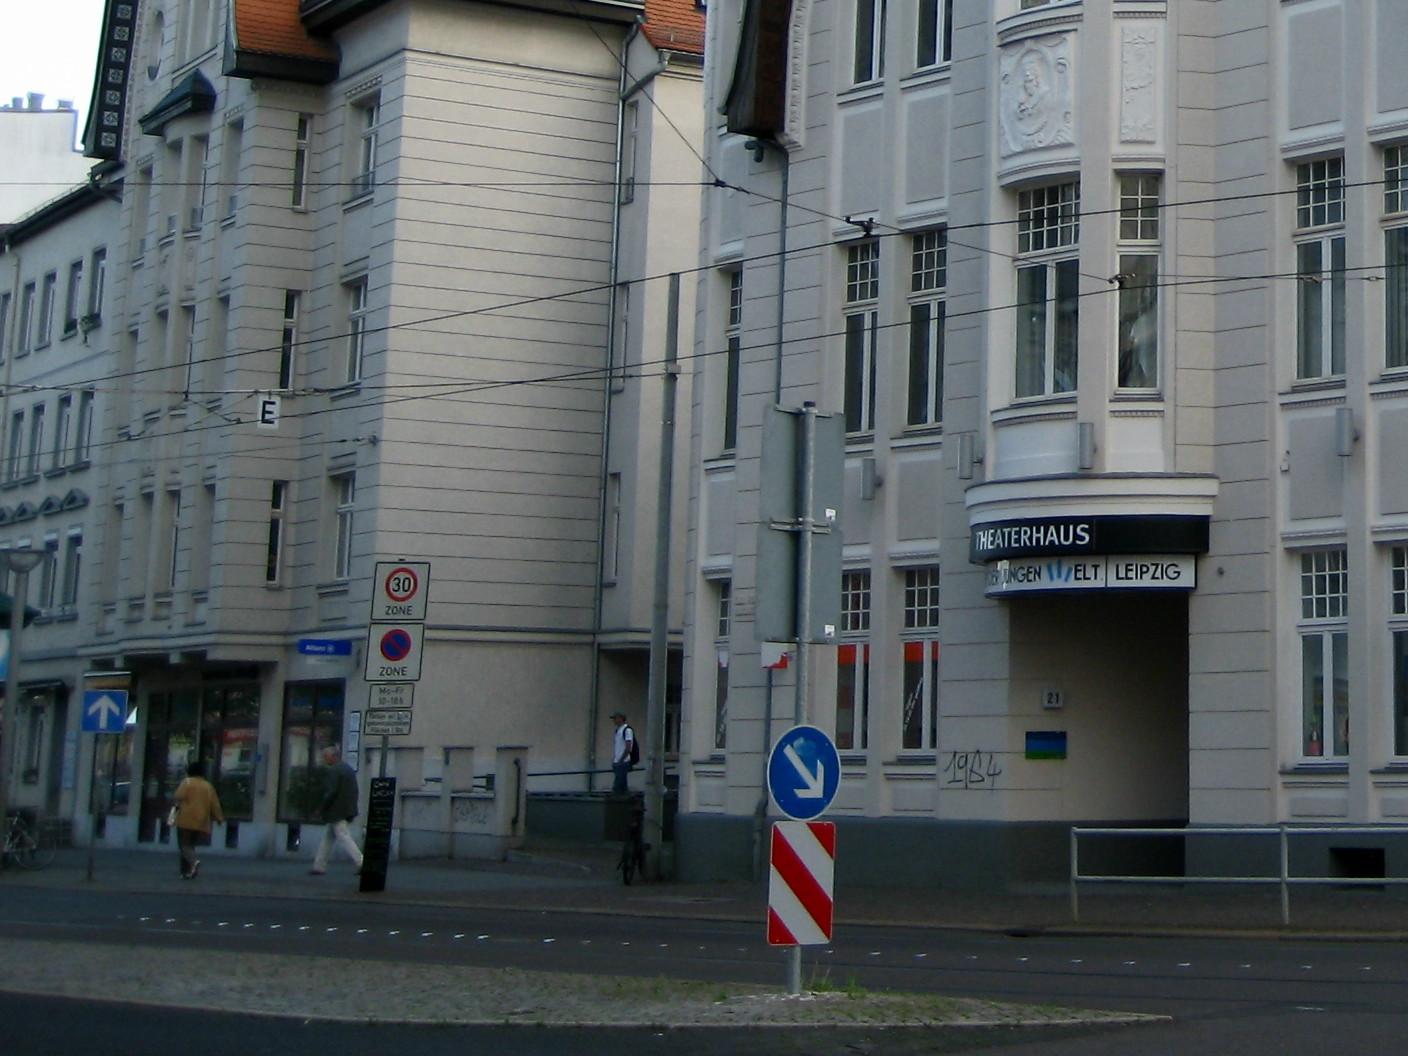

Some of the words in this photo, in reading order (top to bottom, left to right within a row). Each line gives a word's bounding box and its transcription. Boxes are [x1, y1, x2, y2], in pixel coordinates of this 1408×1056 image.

[262, 400, 276, 424] E
[975, 523, 1090, 550] THEATERHAUS
[1115, 563, 1181, 581] LEIPZIG
[392, 577, 411, 592] 30
[385, 605, 413, 615] ZONE
[379, 666, 408, 676] ZONE
[1047, 692, 1060, 704] 21
